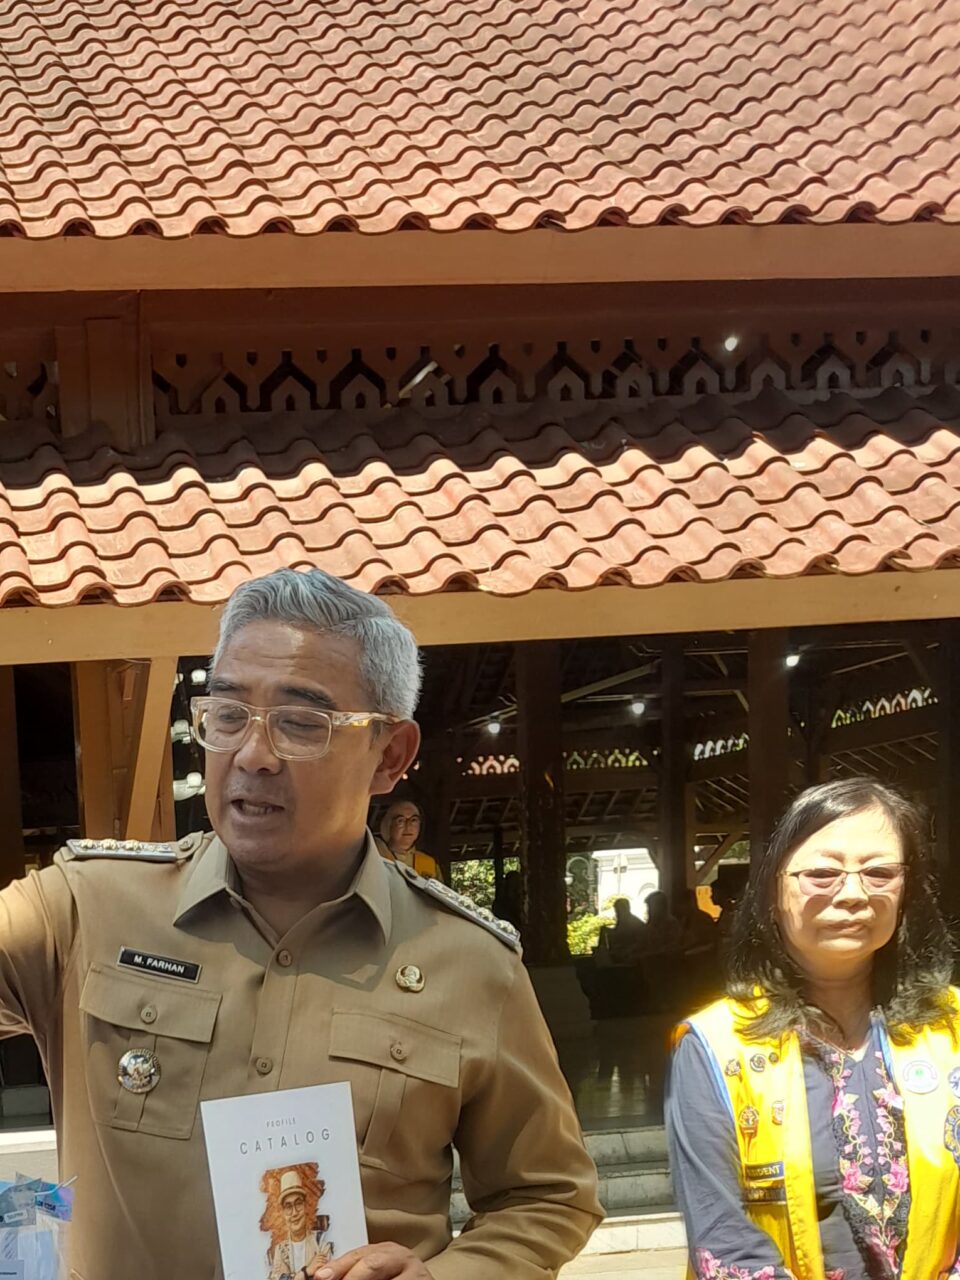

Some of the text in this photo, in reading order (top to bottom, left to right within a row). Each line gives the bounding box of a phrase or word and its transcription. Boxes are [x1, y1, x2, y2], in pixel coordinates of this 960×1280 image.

[133, 954, 185, 974] M. FARHAN
[239, 1128, 330, 1155] CATALOG
